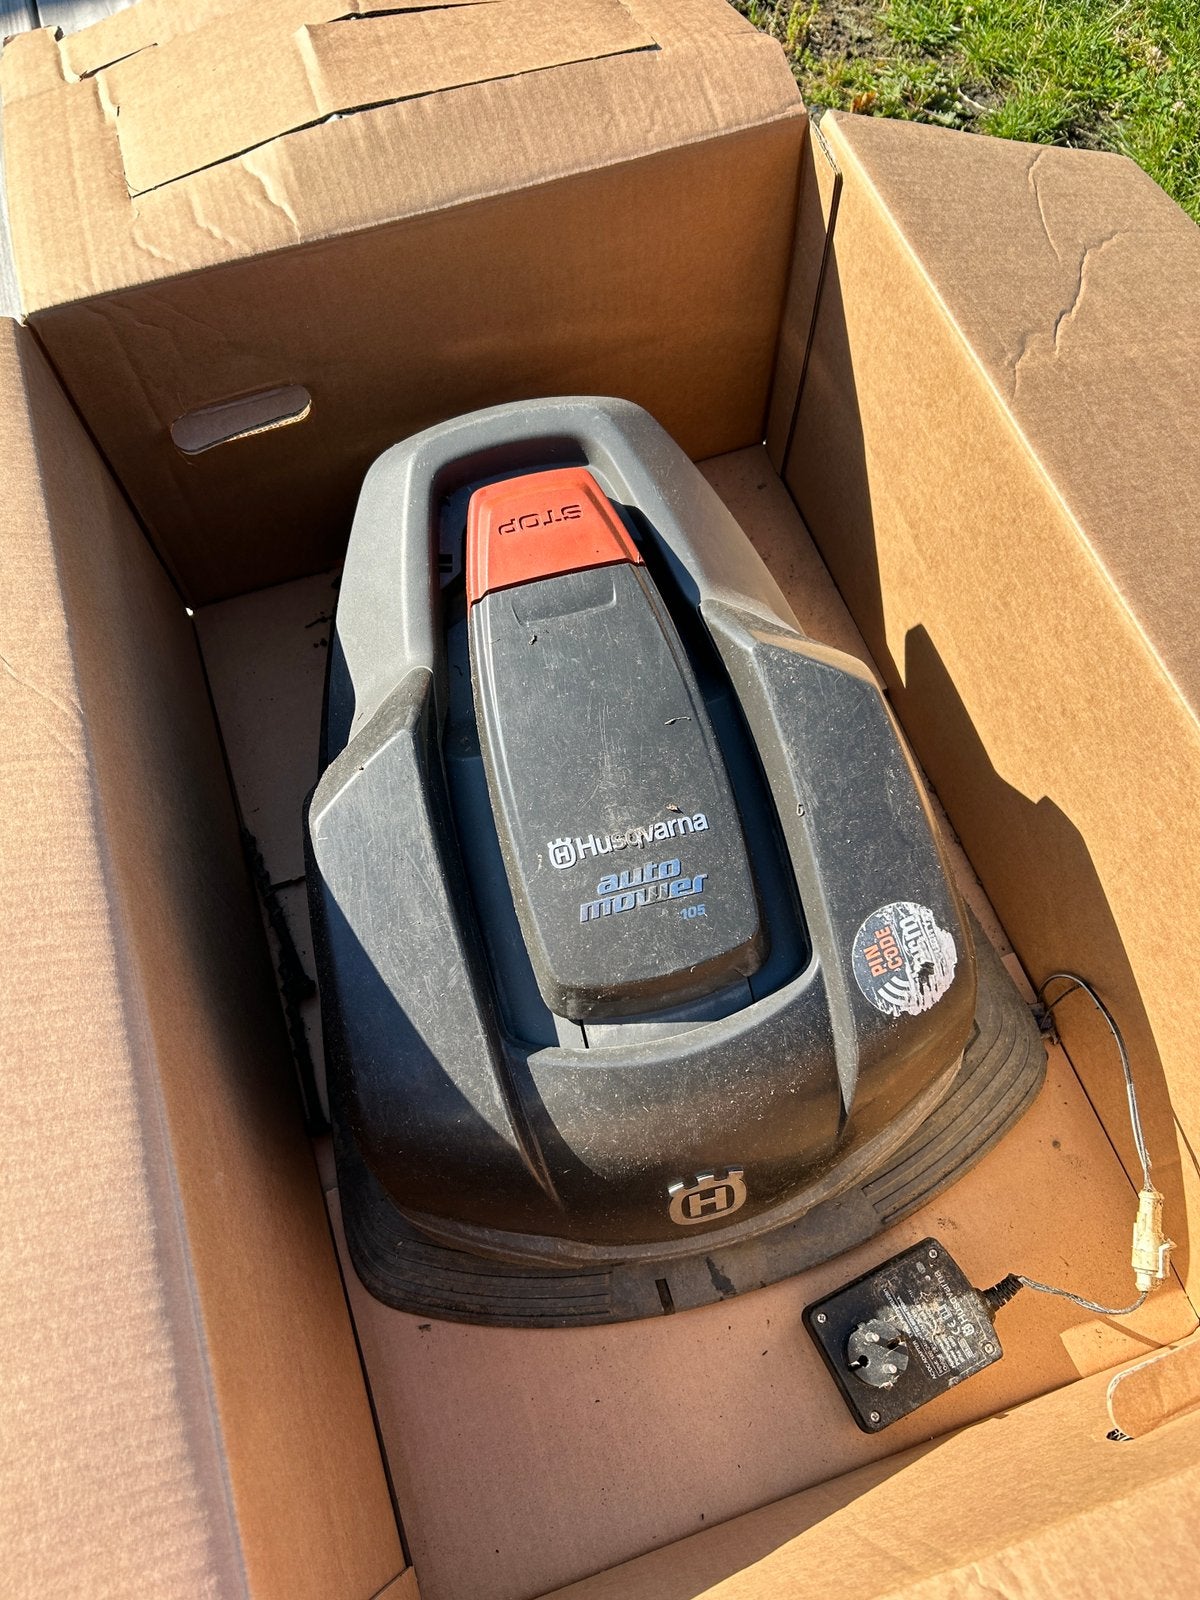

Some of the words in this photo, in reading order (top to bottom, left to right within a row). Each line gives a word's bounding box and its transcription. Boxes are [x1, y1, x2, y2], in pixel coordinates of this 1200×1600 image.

[498, 504, 582, 536] STOP
[573, 813, 709, 860] Husqvarna
[596, 857, 682, 896] auto
[580, 873, 709, 924] mower
[679, 904, 707, 921] 105
[863, 944, 888, 978] PIN
[875, 926, 904, 970] CODE
[934, 1269, 968, 1323] Husqvarna
